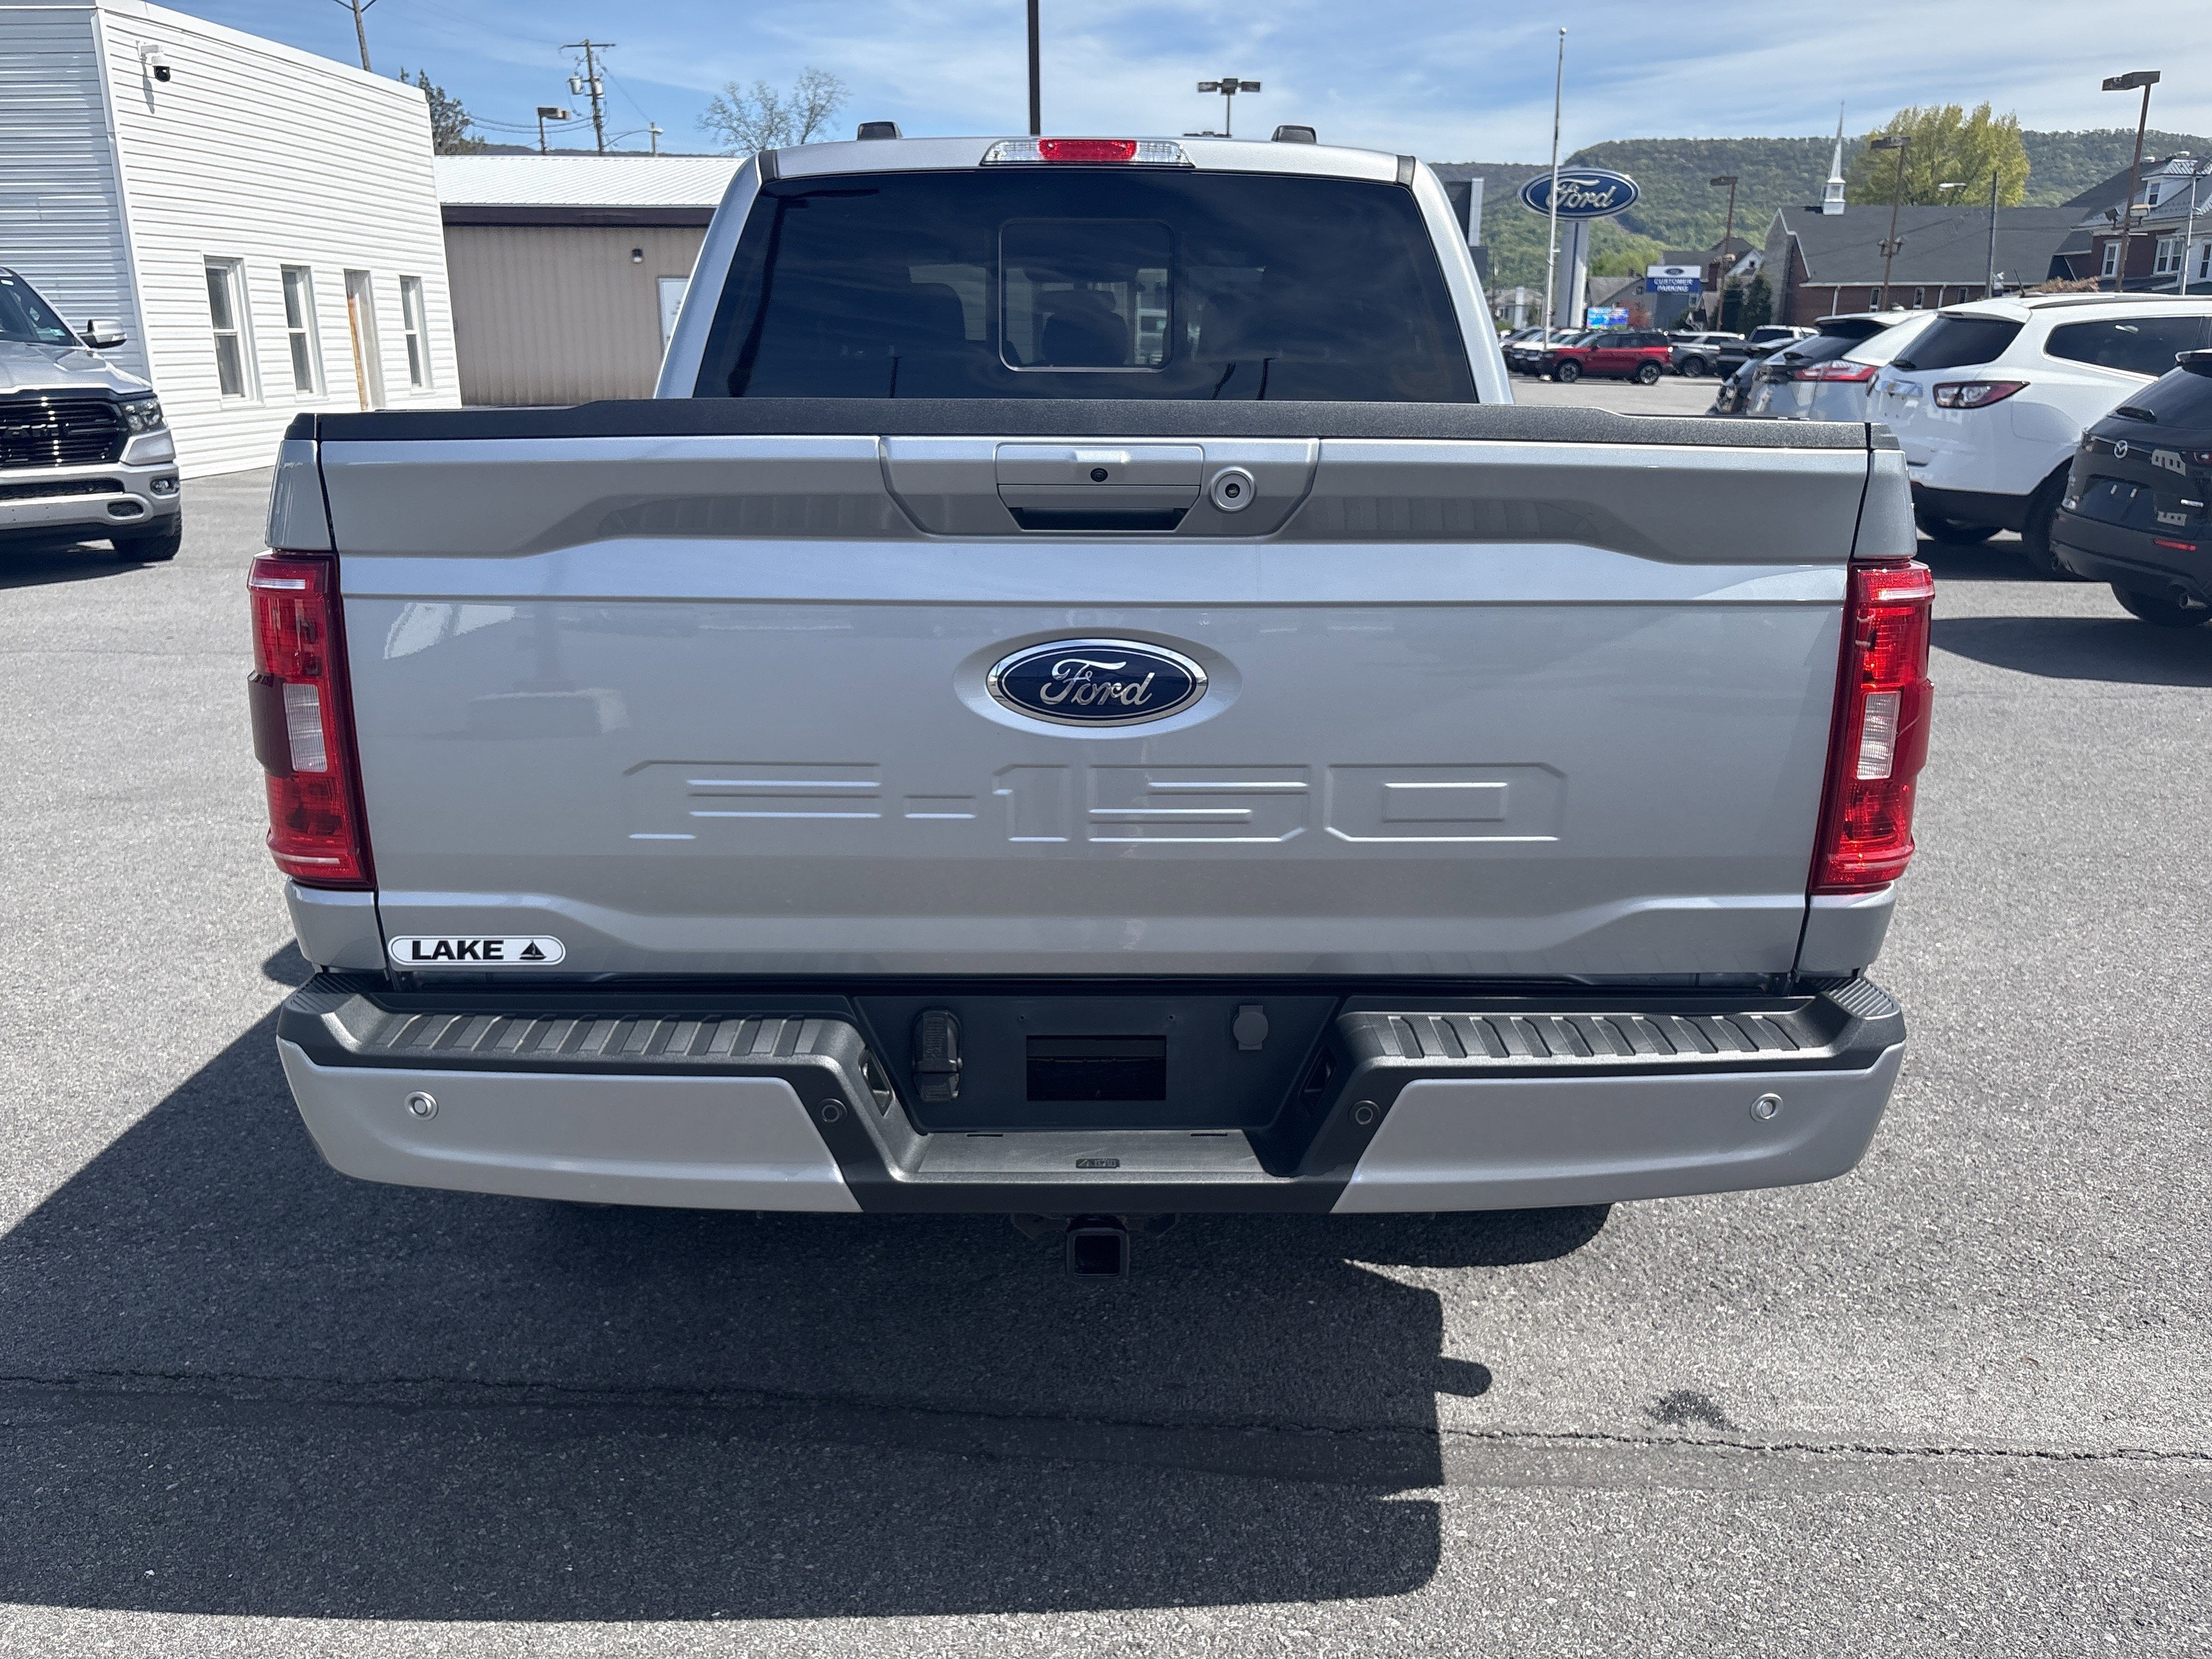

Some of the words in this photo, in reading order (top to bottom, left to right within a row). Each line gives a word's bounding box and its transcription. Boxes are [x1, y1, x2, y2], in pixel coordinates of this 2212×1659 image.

[1545, 177, 1617, 208] Ford
[0, 423, 59, 438] AM
[1039, 658, 1153, 706] Ford
[622, 759, 1567, 844] F-150
[411, 940, 504, 961] LAKE
